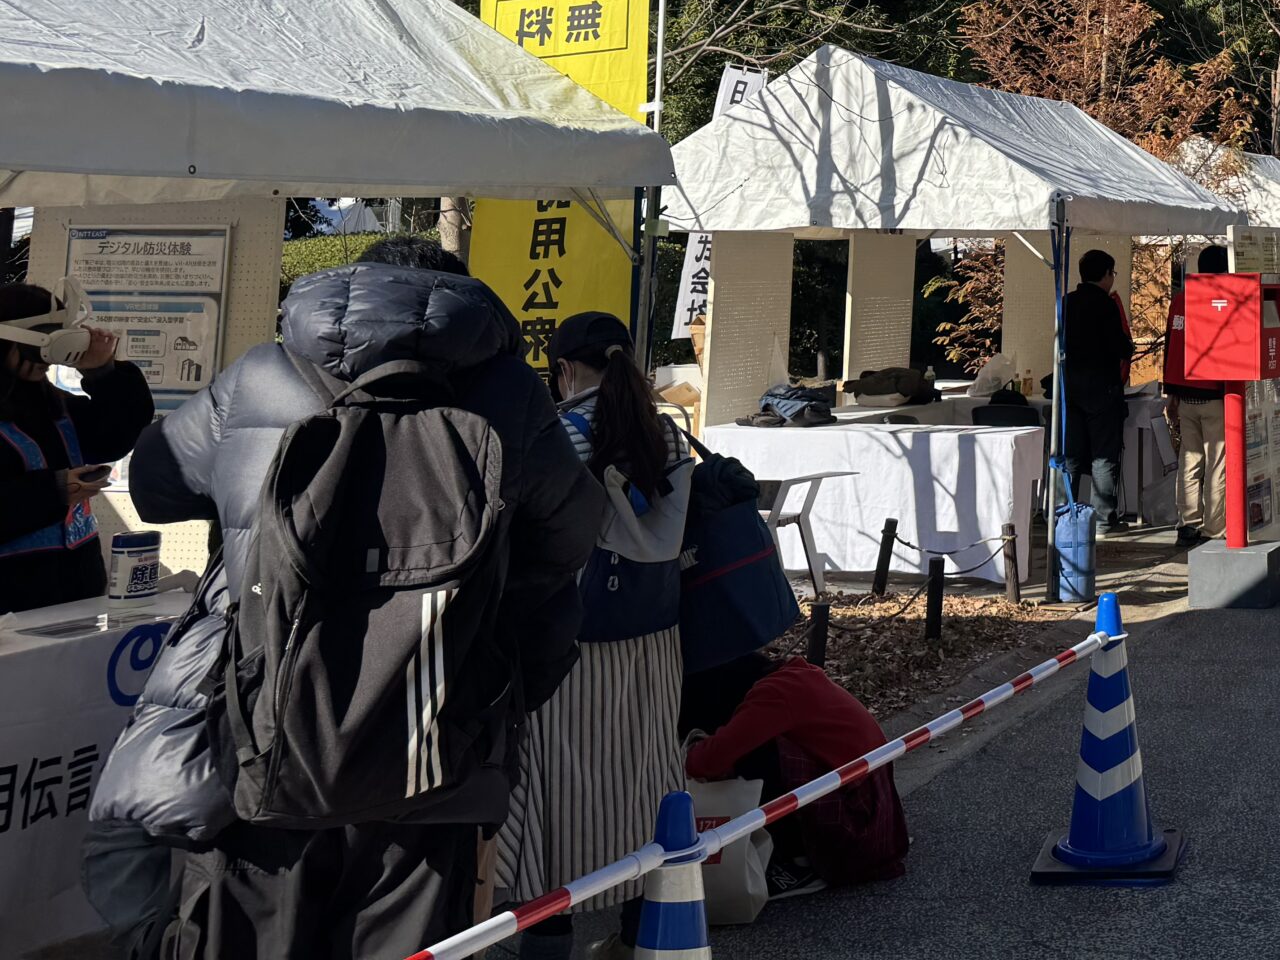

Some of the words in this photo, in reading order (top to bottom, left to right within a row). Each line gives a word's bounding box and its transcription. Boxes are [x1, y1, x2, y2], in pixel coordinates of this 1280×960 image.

[97, 241, 192, 256] デジタル防災体験
